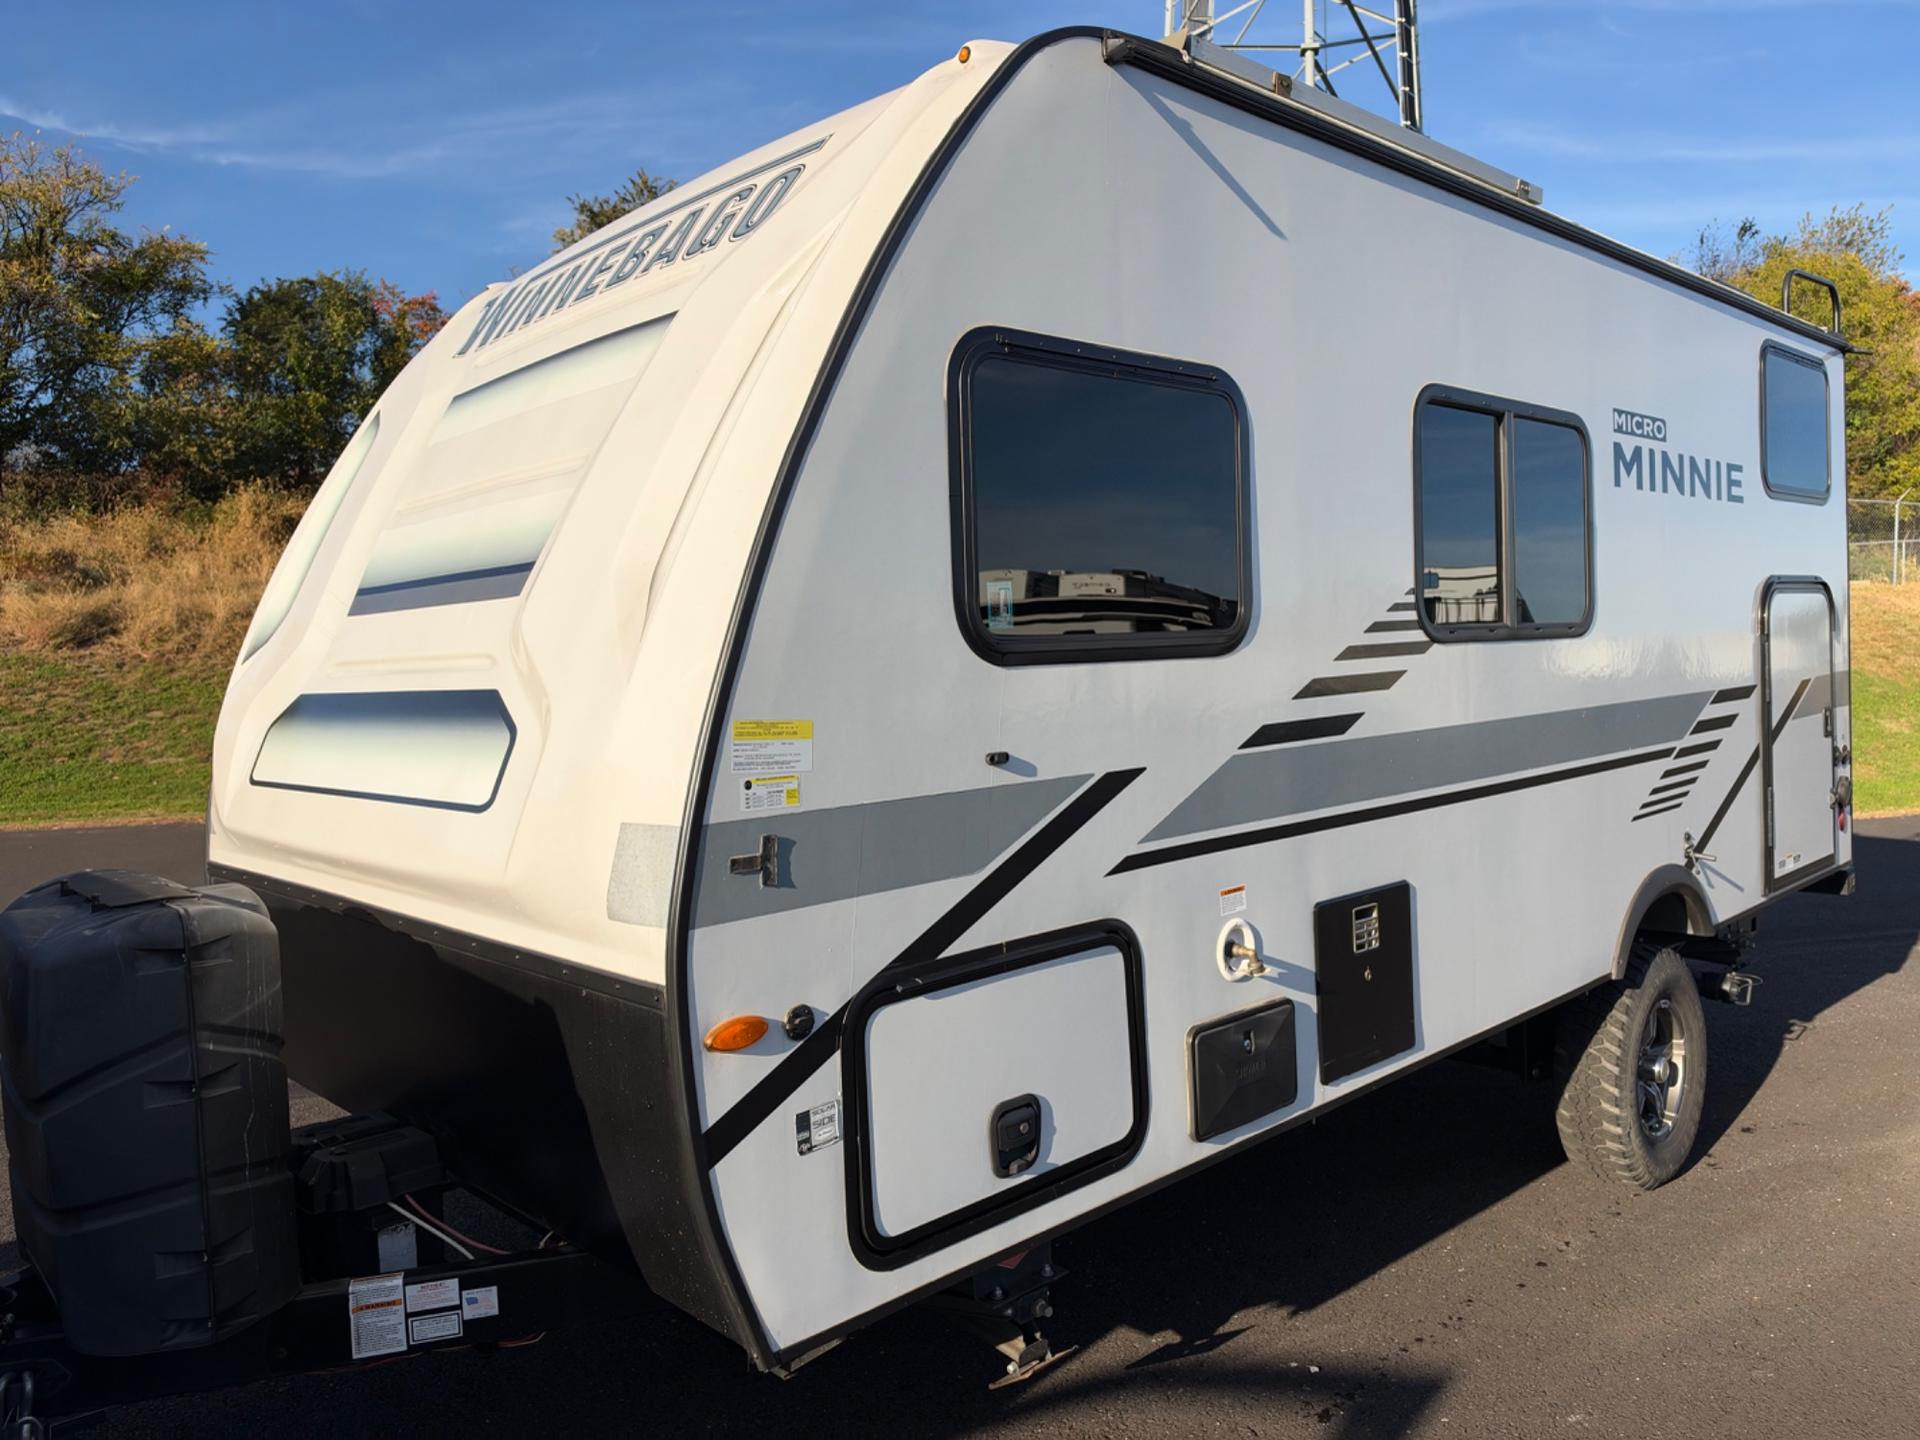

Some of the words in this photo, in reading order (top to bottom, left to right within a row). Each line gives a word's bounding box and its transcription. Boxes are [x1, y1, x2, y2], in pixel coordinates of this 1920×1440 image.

[452, 163, 806, 358] WINNEBAGO
[1613, 410, 1666, 439] MICRO
[1613, 441, 1744, 504] MINNIE
